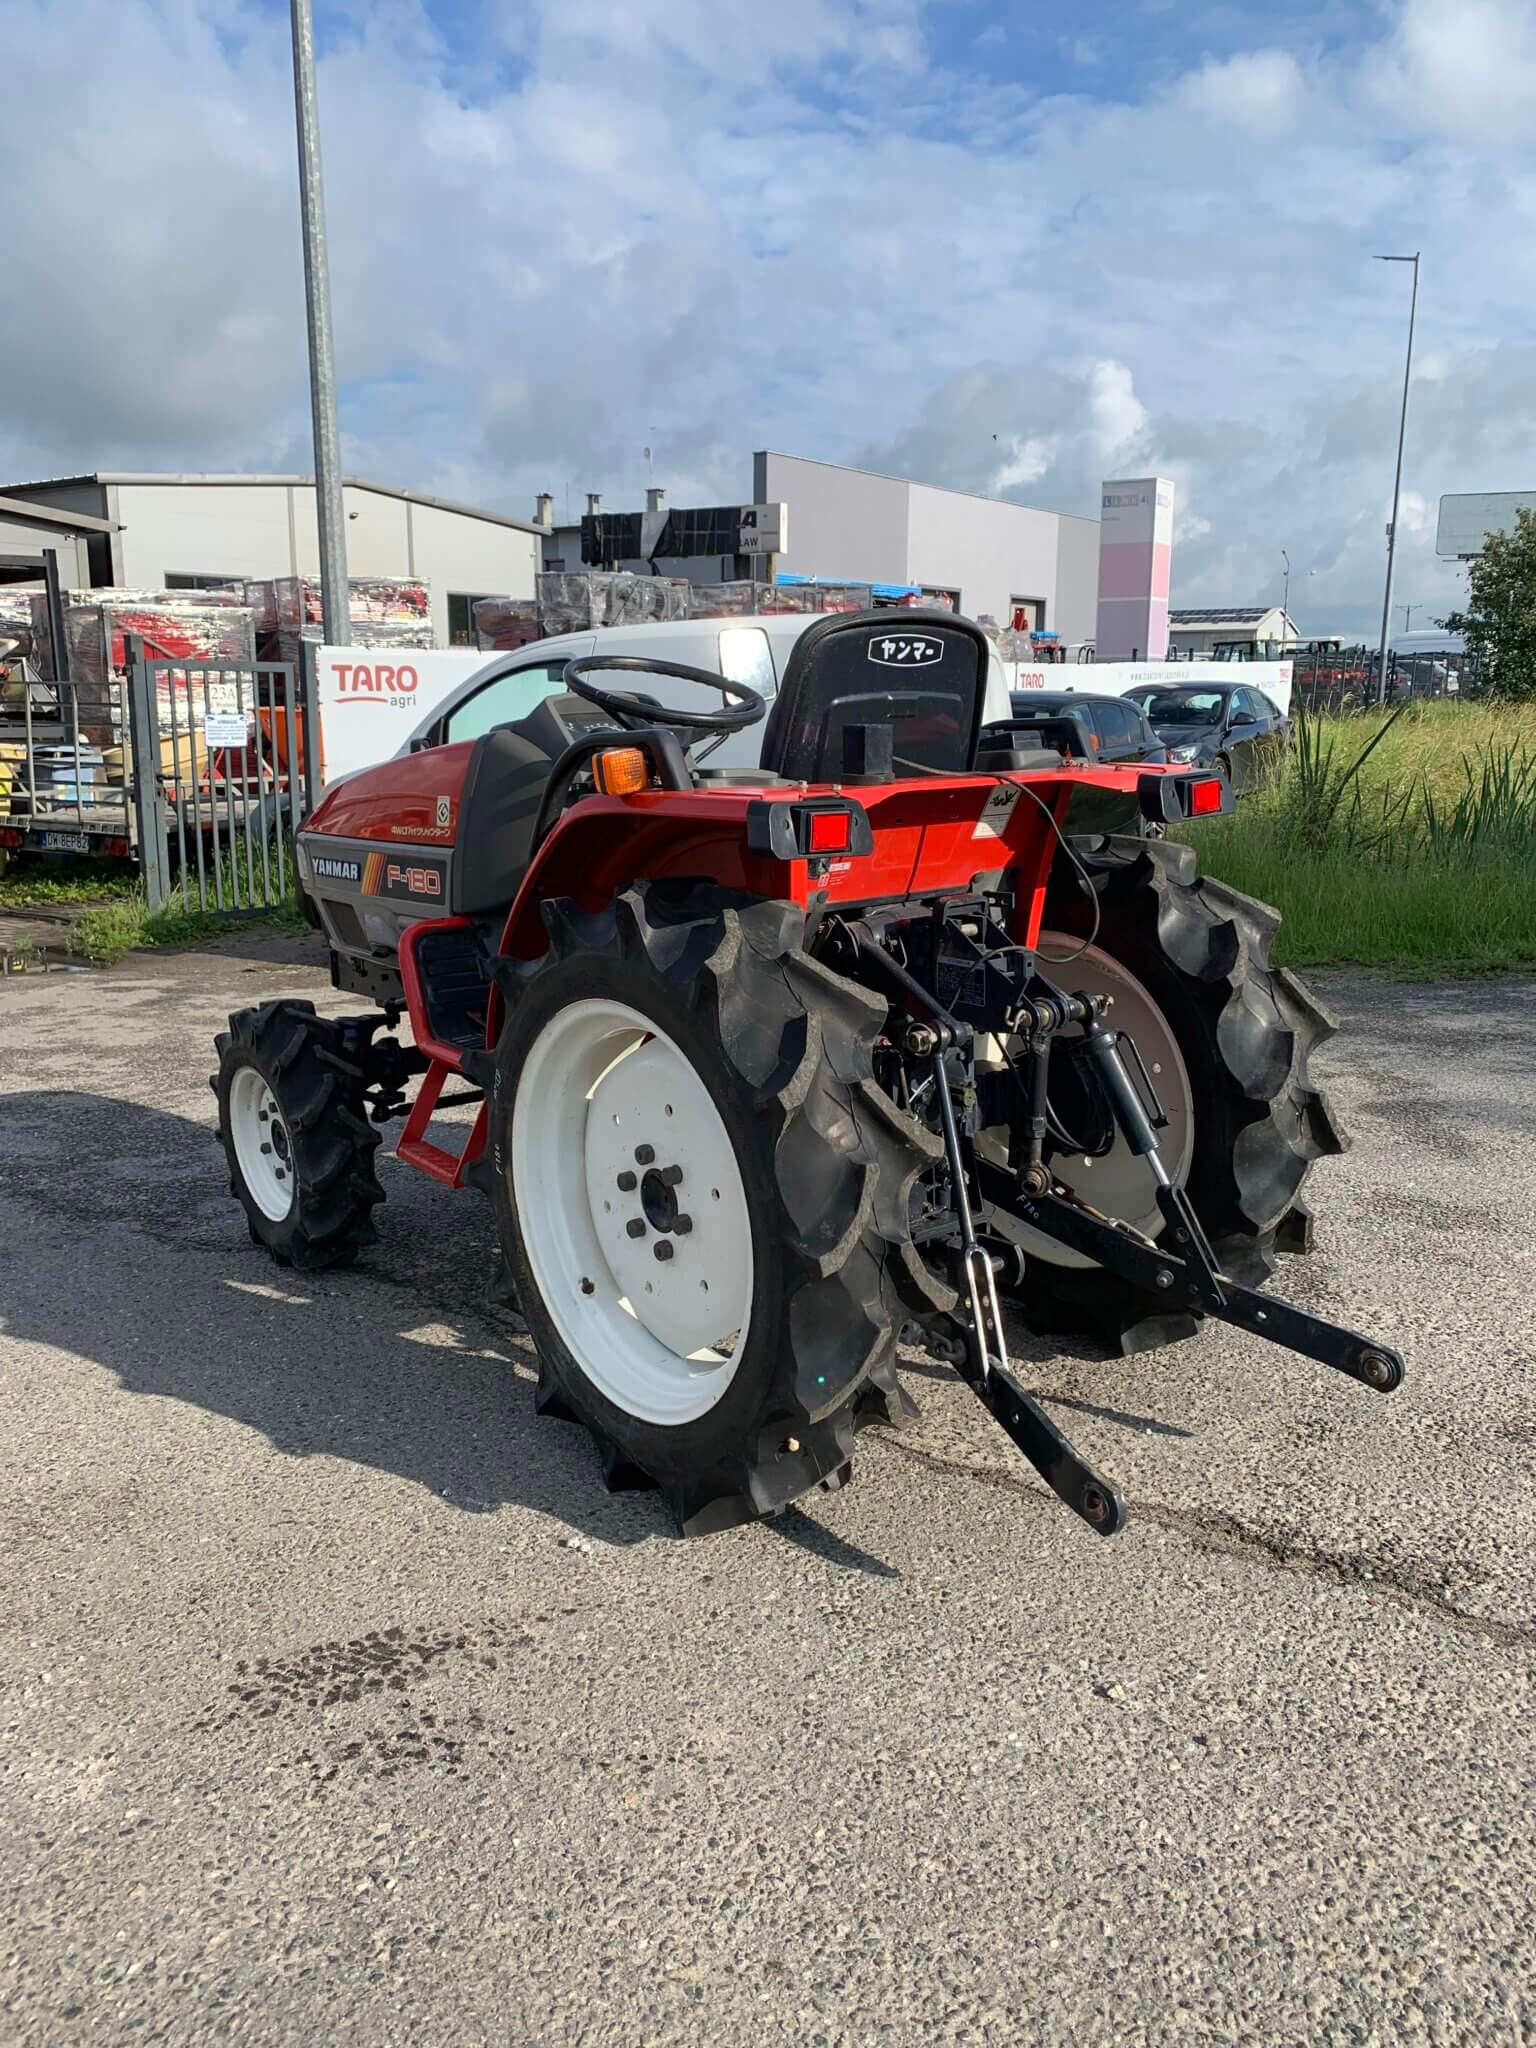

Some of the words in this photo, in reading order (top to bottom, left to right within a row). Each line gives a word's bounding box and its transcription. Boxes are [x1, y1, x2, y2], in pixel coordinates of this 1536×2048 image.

[881, 640, 934, 660] ヤンマー
[331, 664, 418, 692] TARO
[1020, 673, 1045, 688] TARO
[211, 687, 236, 700] 23A
[390, 694, 416, 708] agri
[312, 857, 359, 880] YANMAR
[387, 864, 440, 895] F-180
